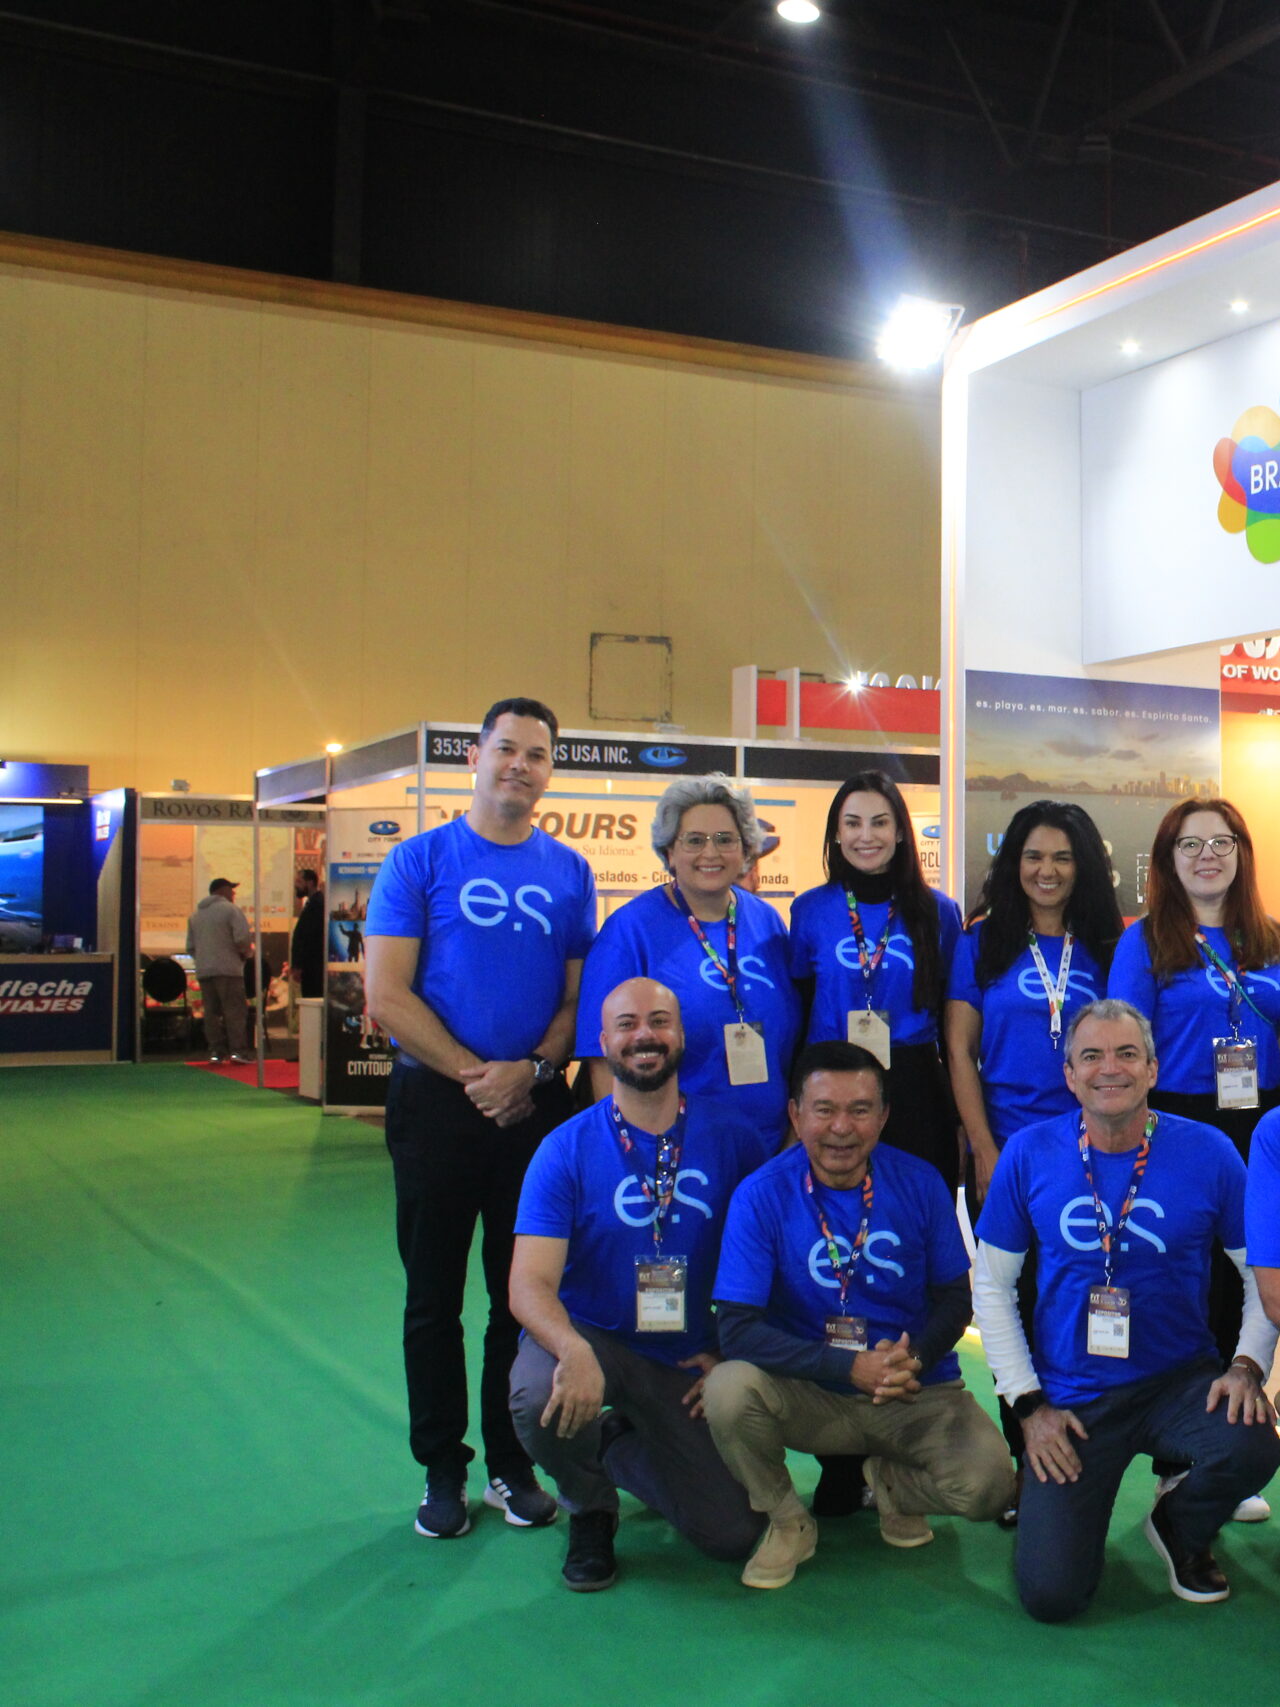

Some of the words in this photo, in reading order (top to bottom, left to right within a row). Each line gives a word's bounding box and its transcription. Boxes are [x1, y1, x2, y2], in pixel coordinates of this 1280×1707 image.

[1222, 664, 1249, 679] OF
[433, 738, 471, 757] 3535
[571, 744, 600, 762] USA
[604, 746, 632, 764] INC.
